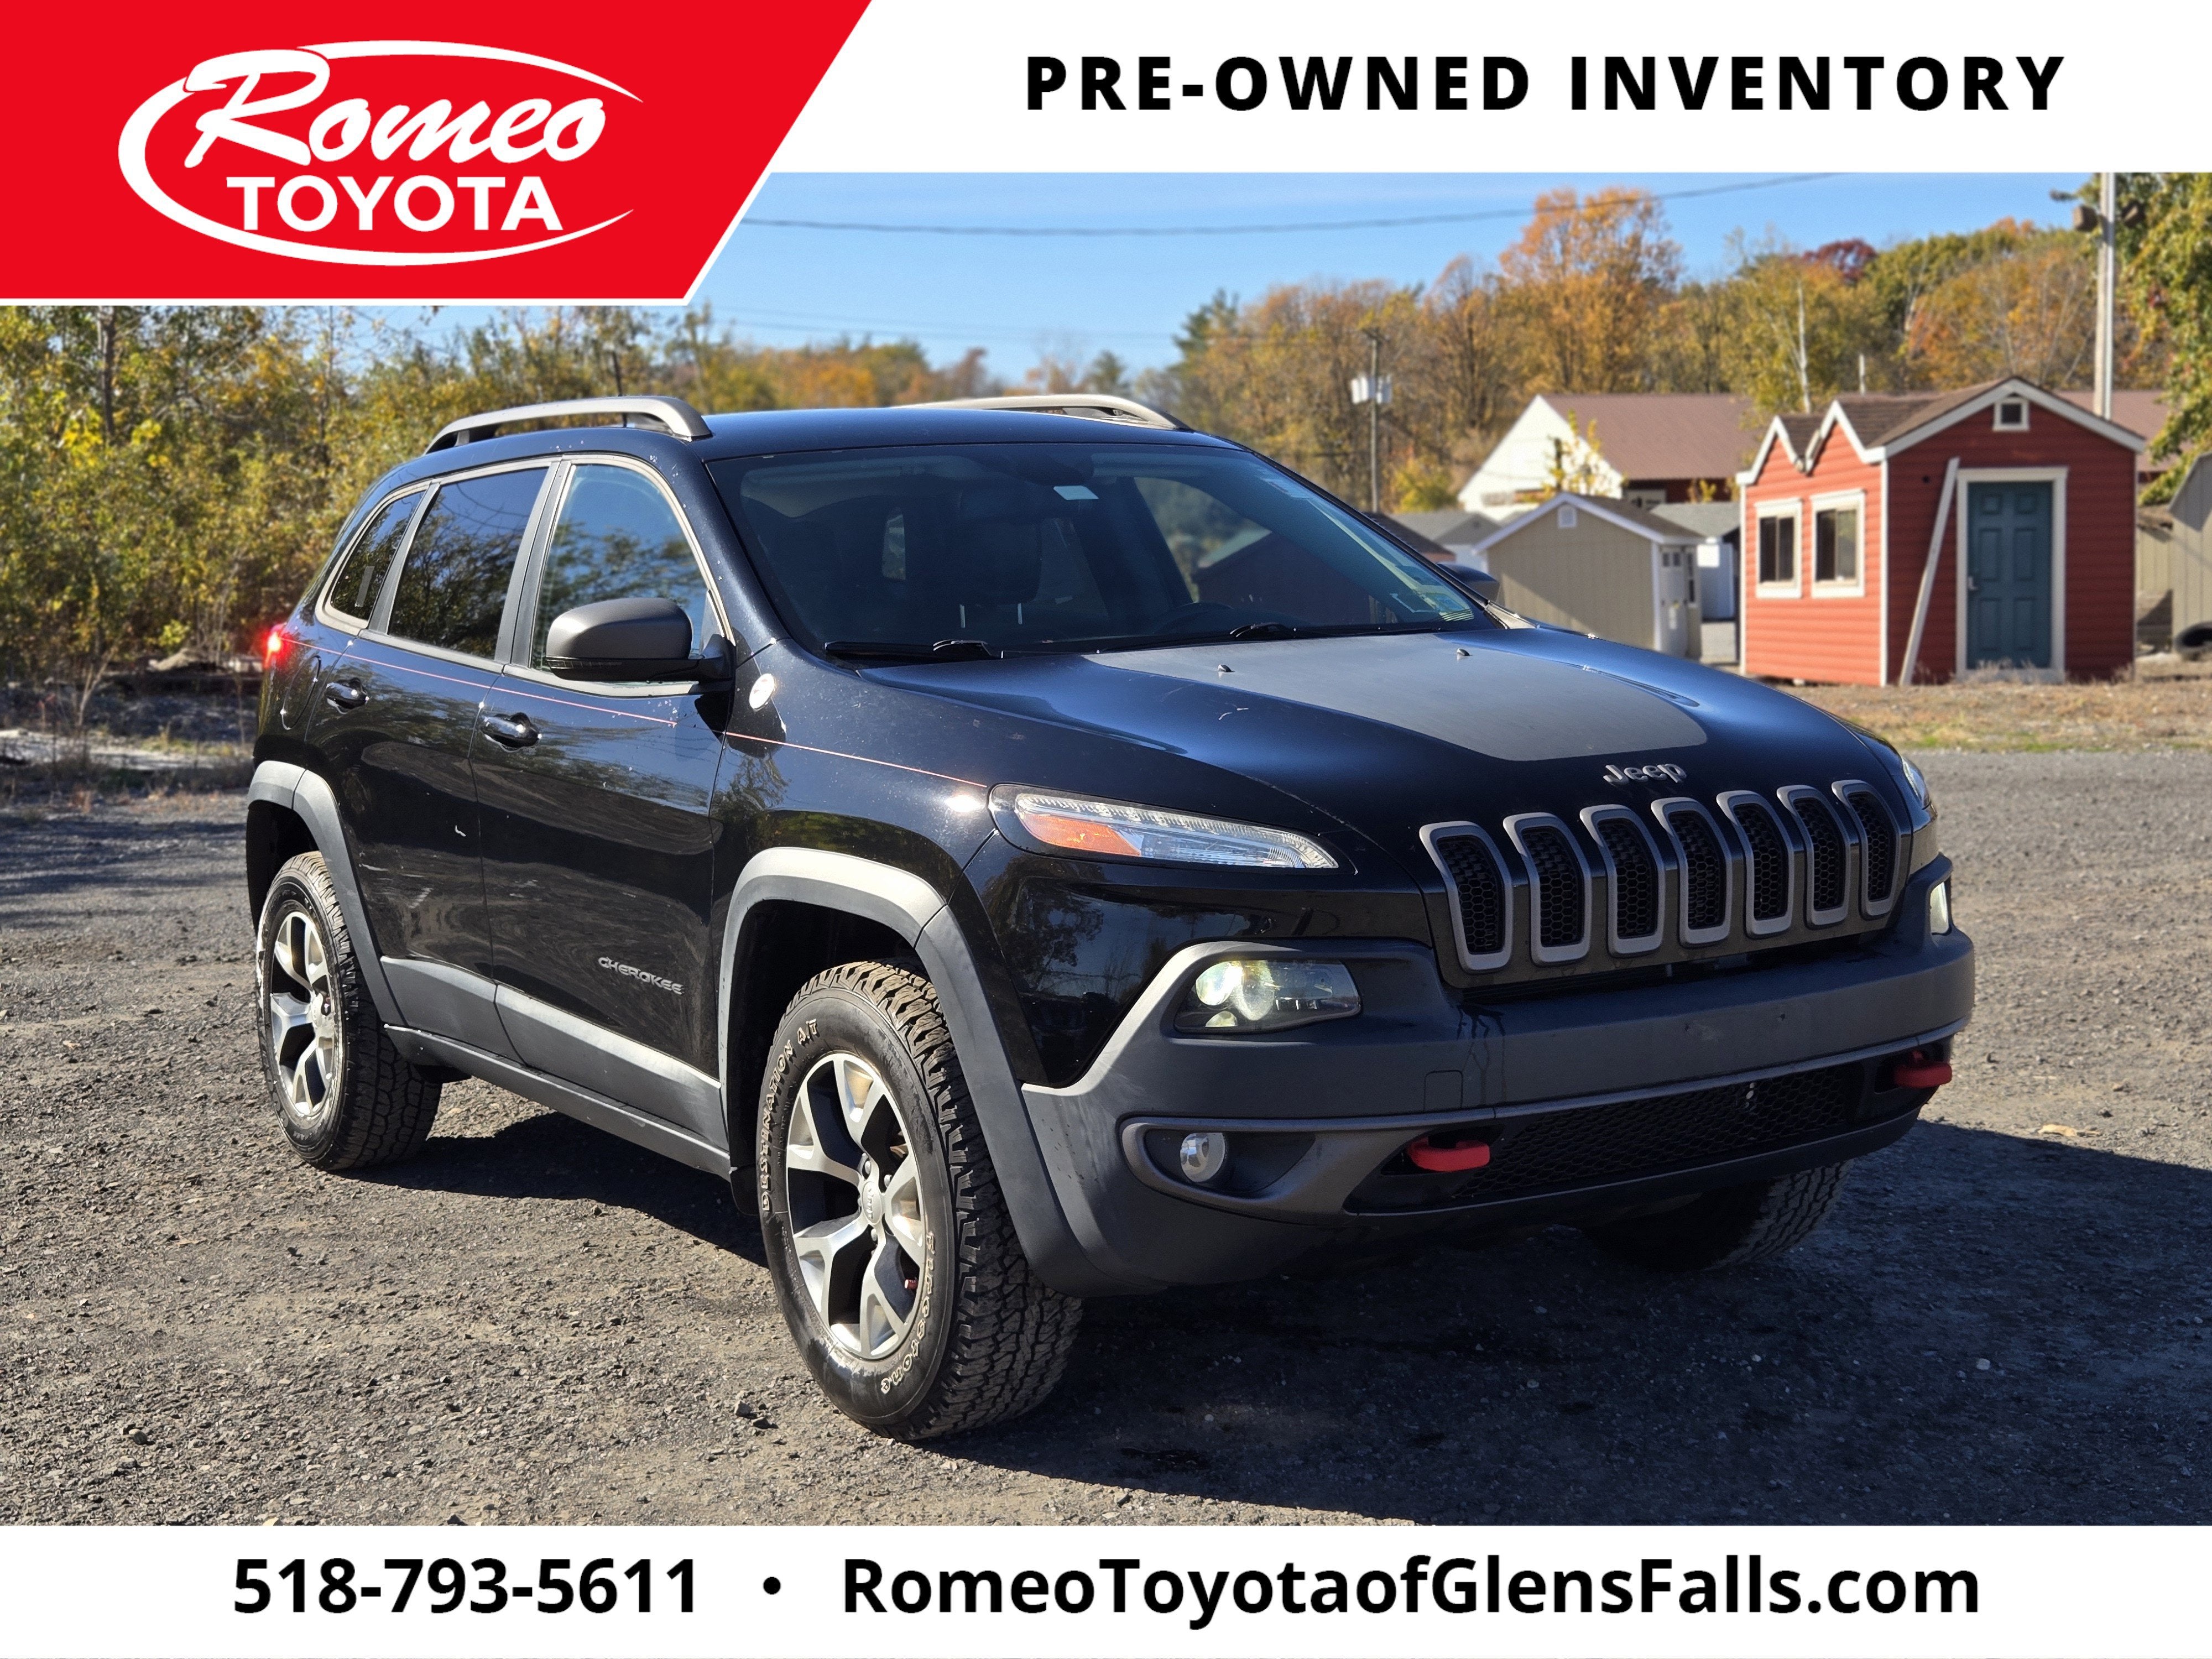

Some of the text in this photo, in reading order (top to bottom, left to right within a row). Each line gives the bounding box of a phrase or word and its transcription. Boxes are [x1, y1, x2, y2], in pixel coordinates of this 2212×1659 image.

[1603, 763, 1687, 785] Jeep
[598, 956, 685, 995] CHEROKEE
[760, 1039, 794, 1212] DESTINATION
